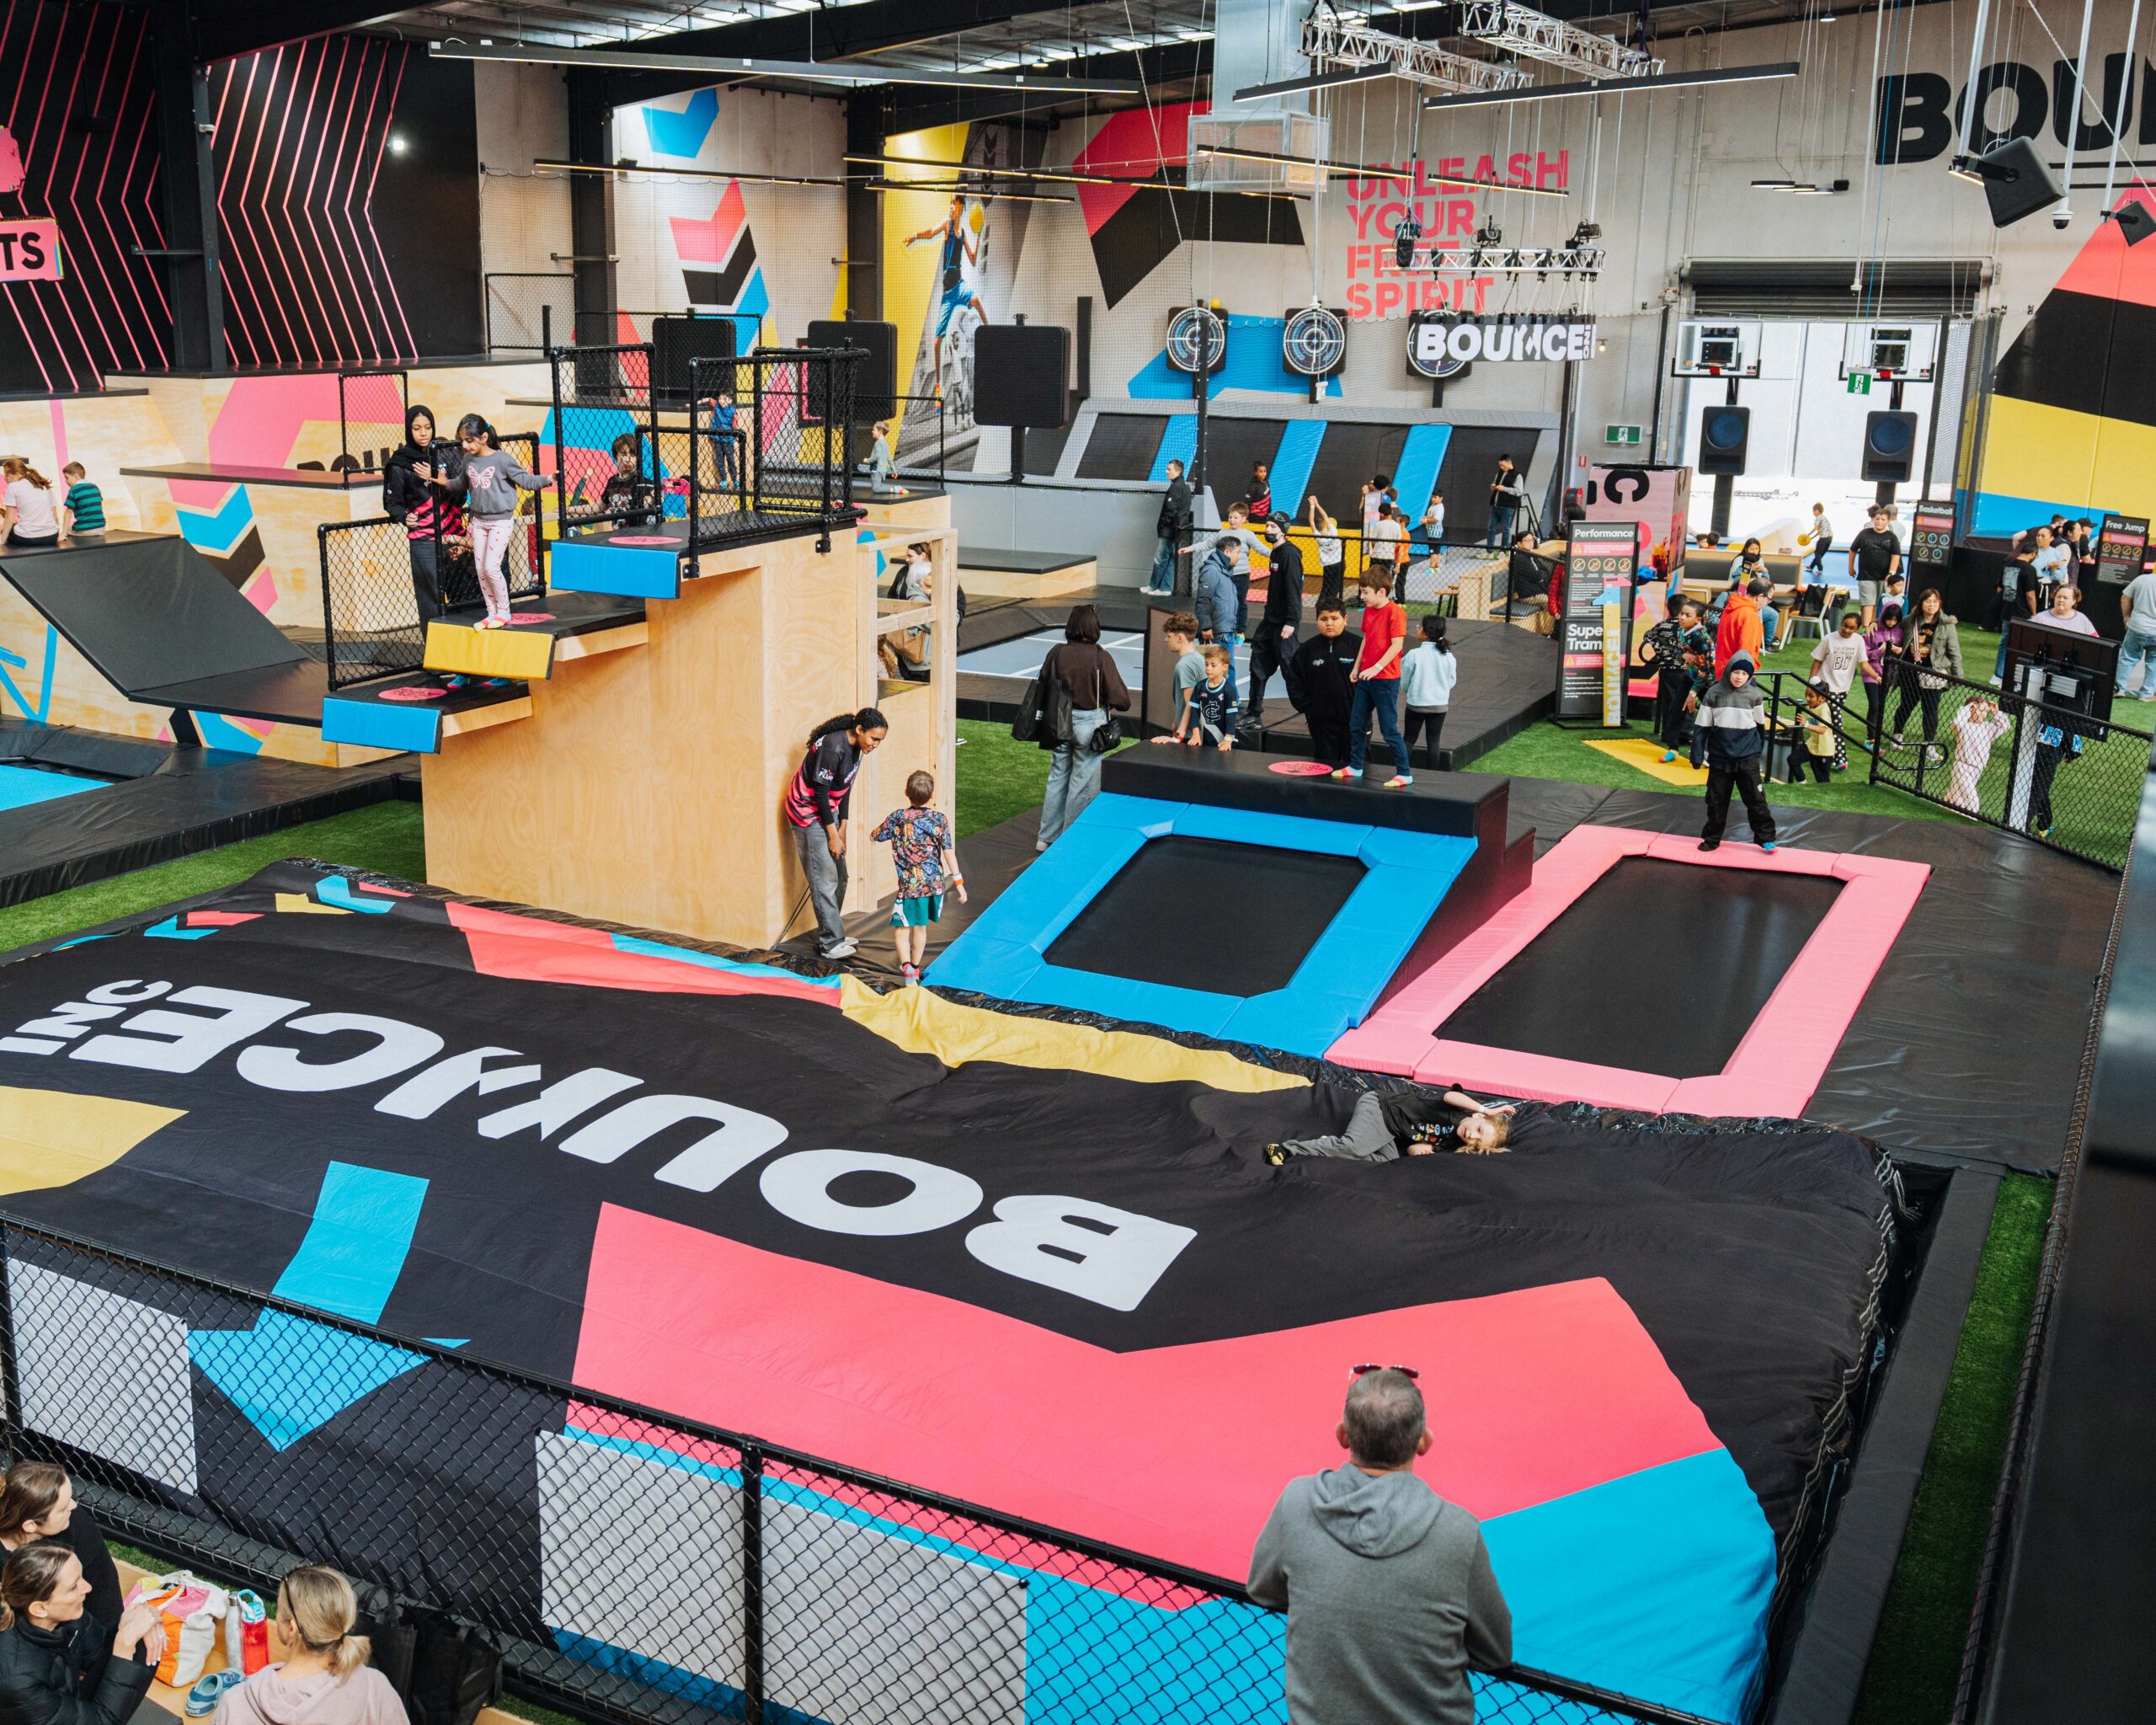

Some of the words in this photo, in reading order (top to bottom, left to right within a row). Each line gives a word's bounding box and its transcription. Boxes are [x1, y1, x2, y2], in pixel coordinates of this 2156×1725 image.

[1876, 52, 2156, 164] BOU
[1347, 150, 1568, 200] UNLEASH
[1347, 200, 1476, 240] YOUR
[1347, 277, 1494, 318] SPIRIT
[1417, 324, 1584, 361] BOUNCE
[1919, 505, 1953, 515] Basketball
[2105, 521, 2122, 529] Free
[2125, 523, 2145, 533] Jump
[1574, 529, 1634, 537] Performance
[1567, 624, 1603, 639] Supe
[1567, 638, 1603, 652] Tram
[0, 980, 173, 1055] INC
[69, 985, 1198, 1311] BOUNCE
